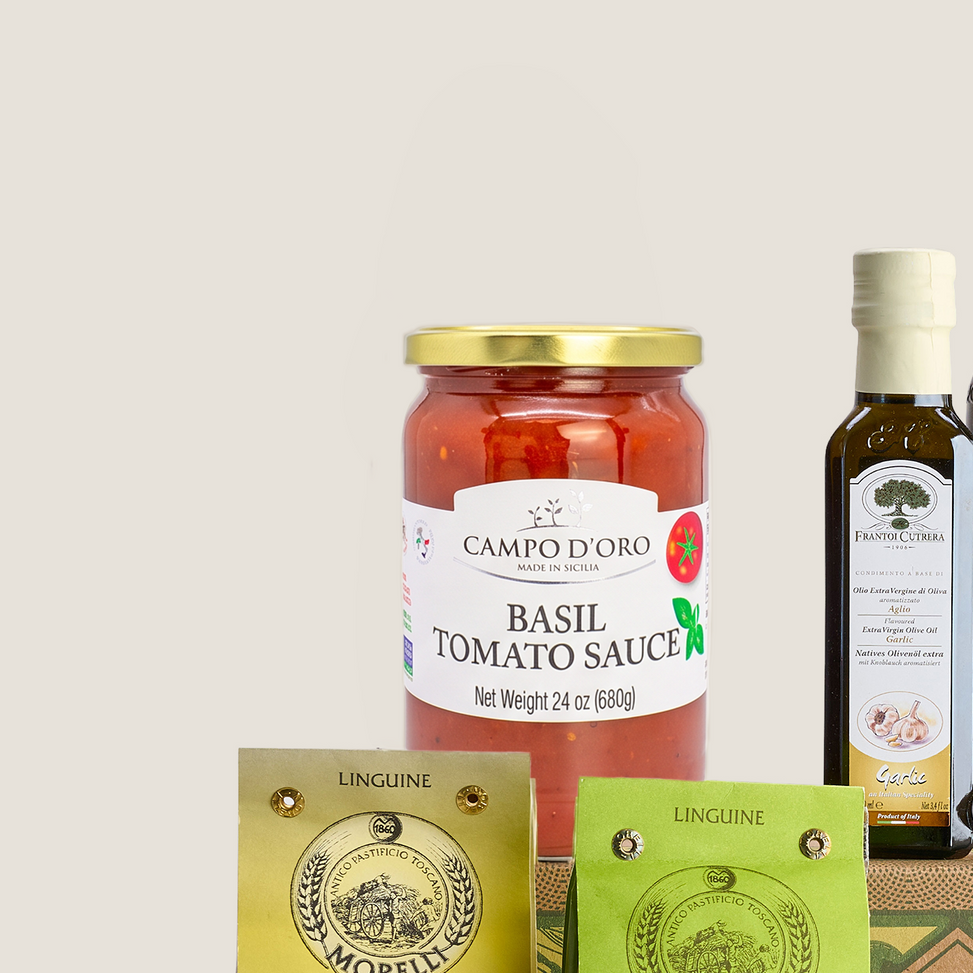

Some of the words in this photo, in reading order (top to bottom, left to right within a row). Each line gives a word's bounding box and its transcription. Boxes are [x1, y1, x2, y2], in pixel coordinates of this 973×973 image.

[463, 536, 560, 558] CAMPO
[568, 535, 650, 558] D'ORO
[855, 530, 897, 542] FRANTOI
[899, 531, 945, 543] CUTRERA
[517, 563, 547, 572] MADE
[549, 564, 561, 572] IN
[564, 563, 599, 572] SICILIA
[507, 603, 606, 633] BASIL
[888, 605, 911, 615] Aglio
[433, 627, 575, 671] TOMATO
[584, 628, 680, 670] SAUCE
[855, 650, 885, 658] Natives
[887, 650, 921, 658] Olivenöl
[475, 686, 496, 708] Net
[501, 688, 548, 715] Weight
[552, 691, 570, 711] 24
[575, 695, 590, 710] oz
[594, 686, 636, 712] (680g)
[338, 771, 432, 788] LINGUINE
[876, 764, 927, 790] Garlic
[674, 807, 765, 825] LINGUINE
[666, 911, 688, 948] ANTICO
[687, 896, 744, 912] PASTIFICIO
[747, 904, 779, 948] TOSCANO
